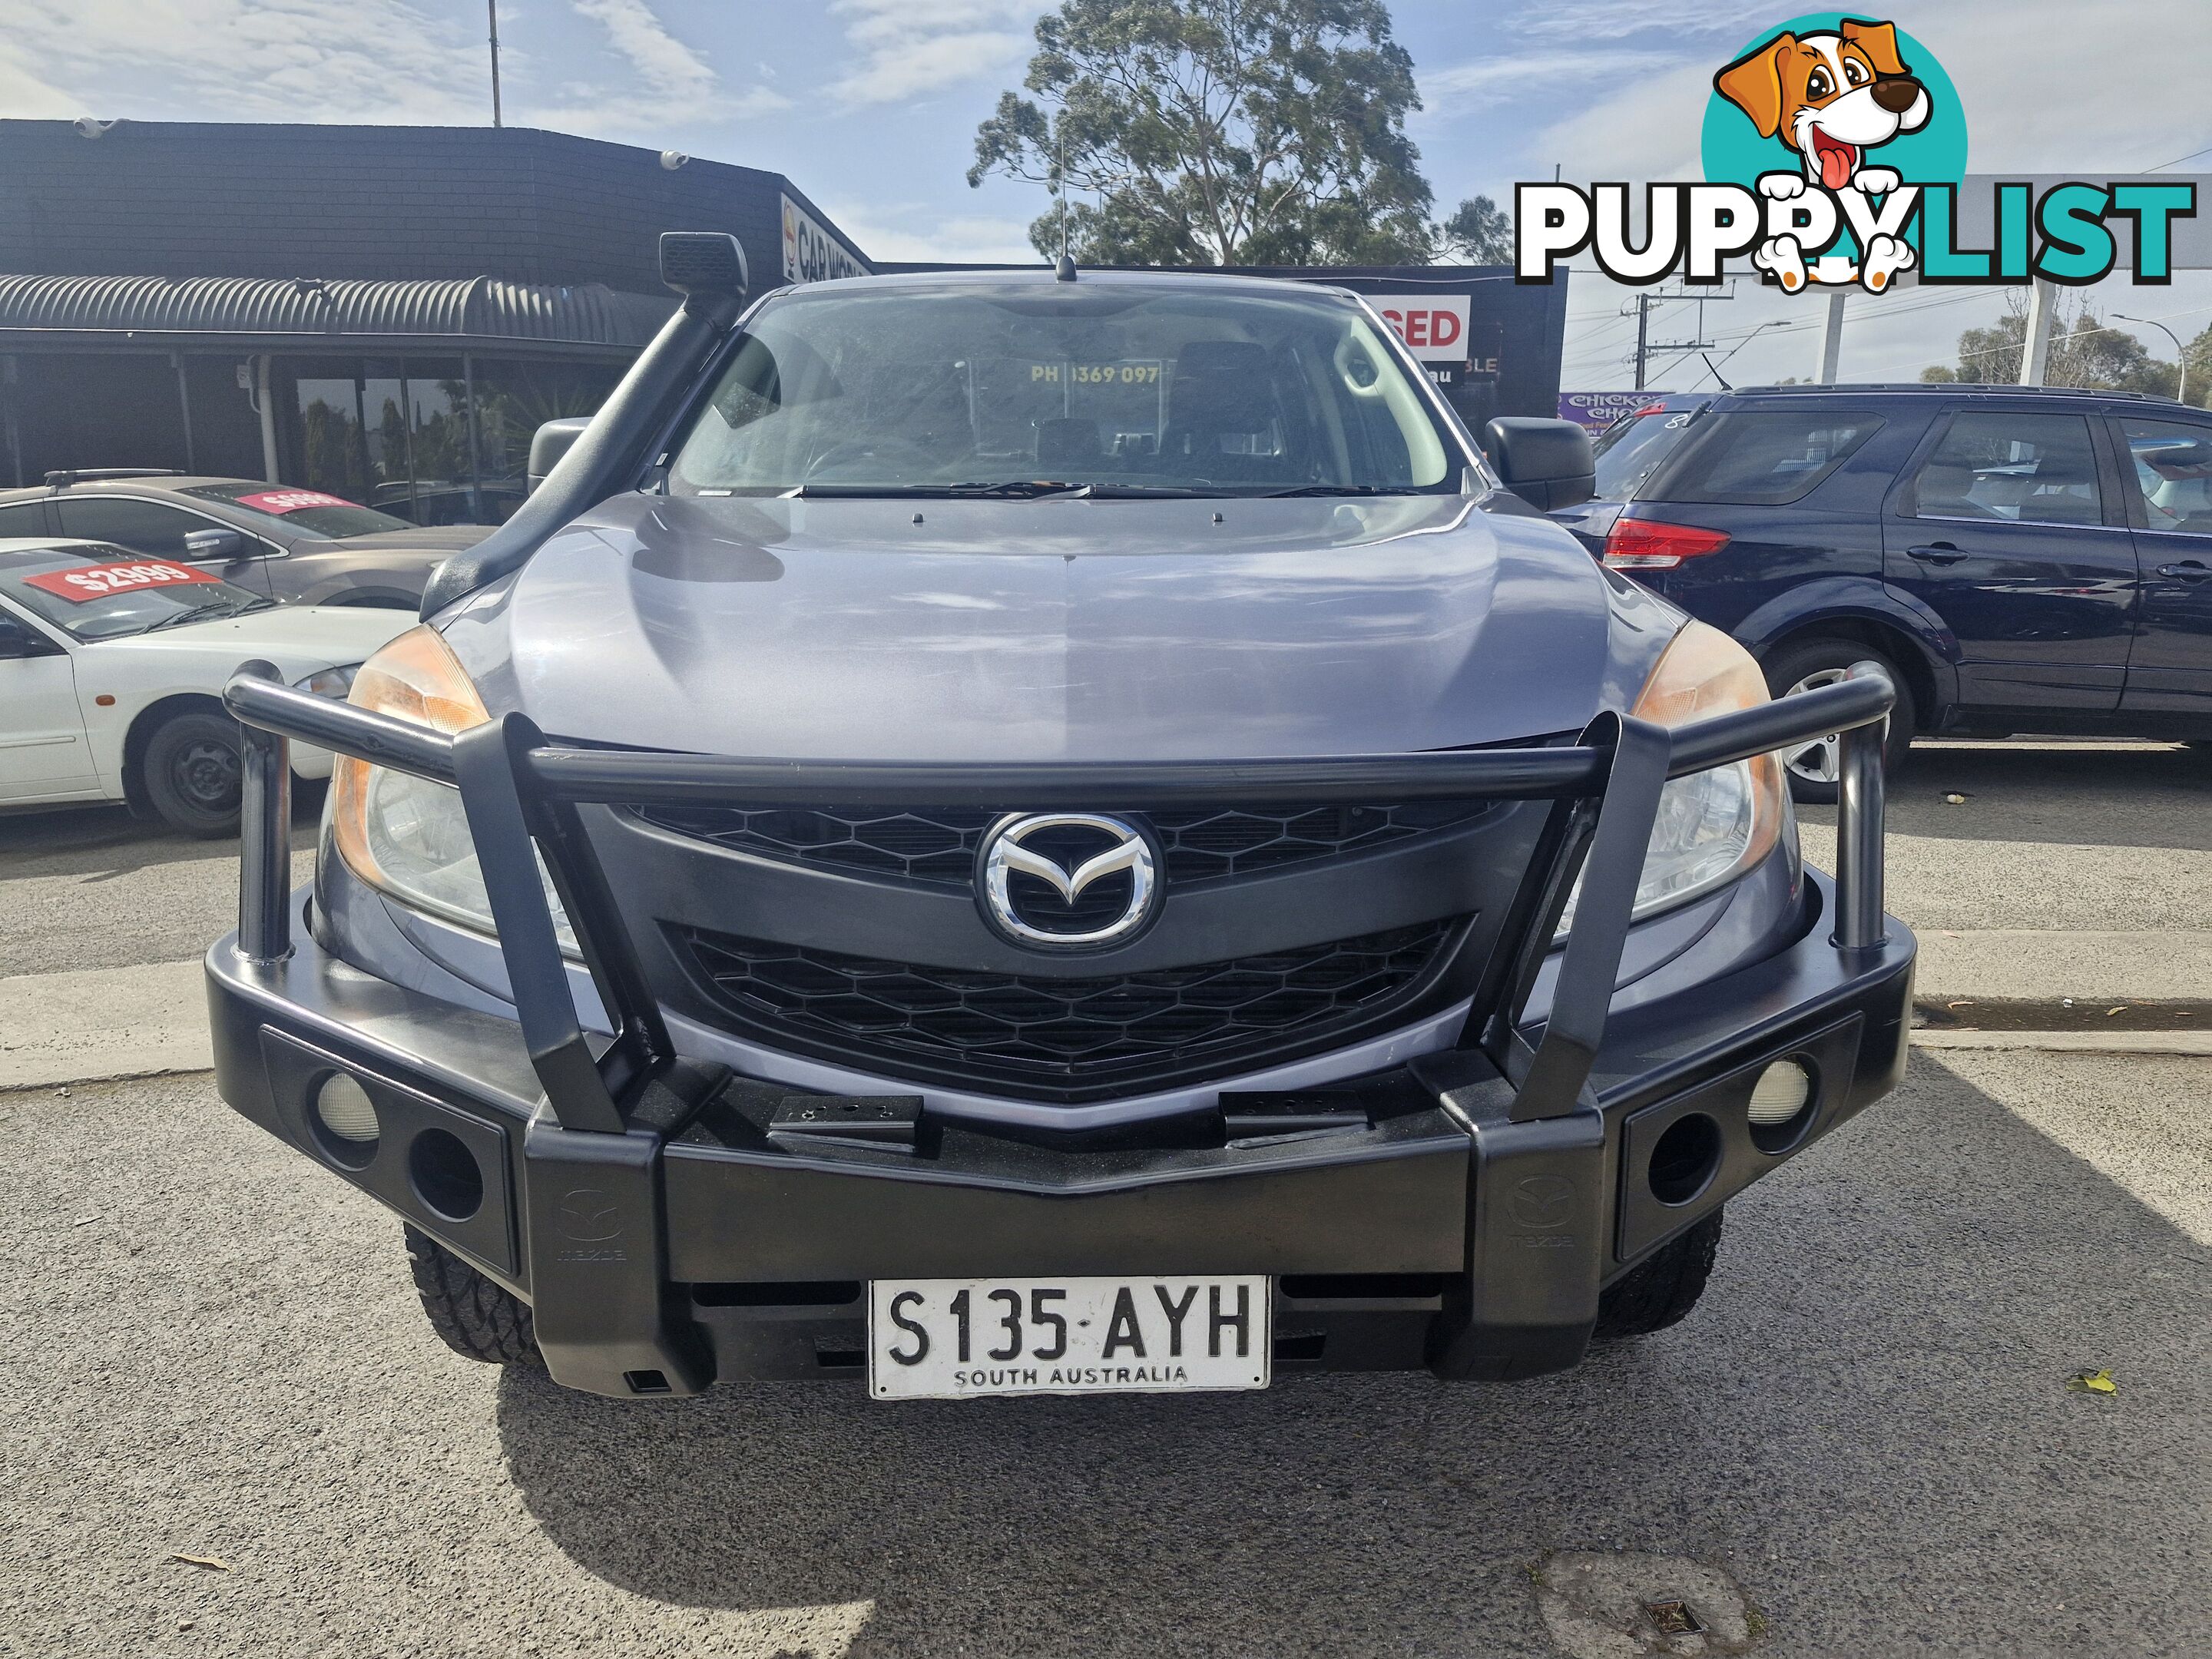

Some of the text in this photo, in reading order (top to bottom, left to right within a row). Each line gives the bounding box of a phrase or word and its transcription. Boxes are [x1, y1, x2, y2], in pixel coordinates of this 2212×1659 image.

[799, 220, 826, 283] CAR
[1031, 366, 1159, 383] PH 369 097
[65, 565, 190, 591] $2999
[953, 1365, 1190, 1387] SOUTH AUSTRALIA
